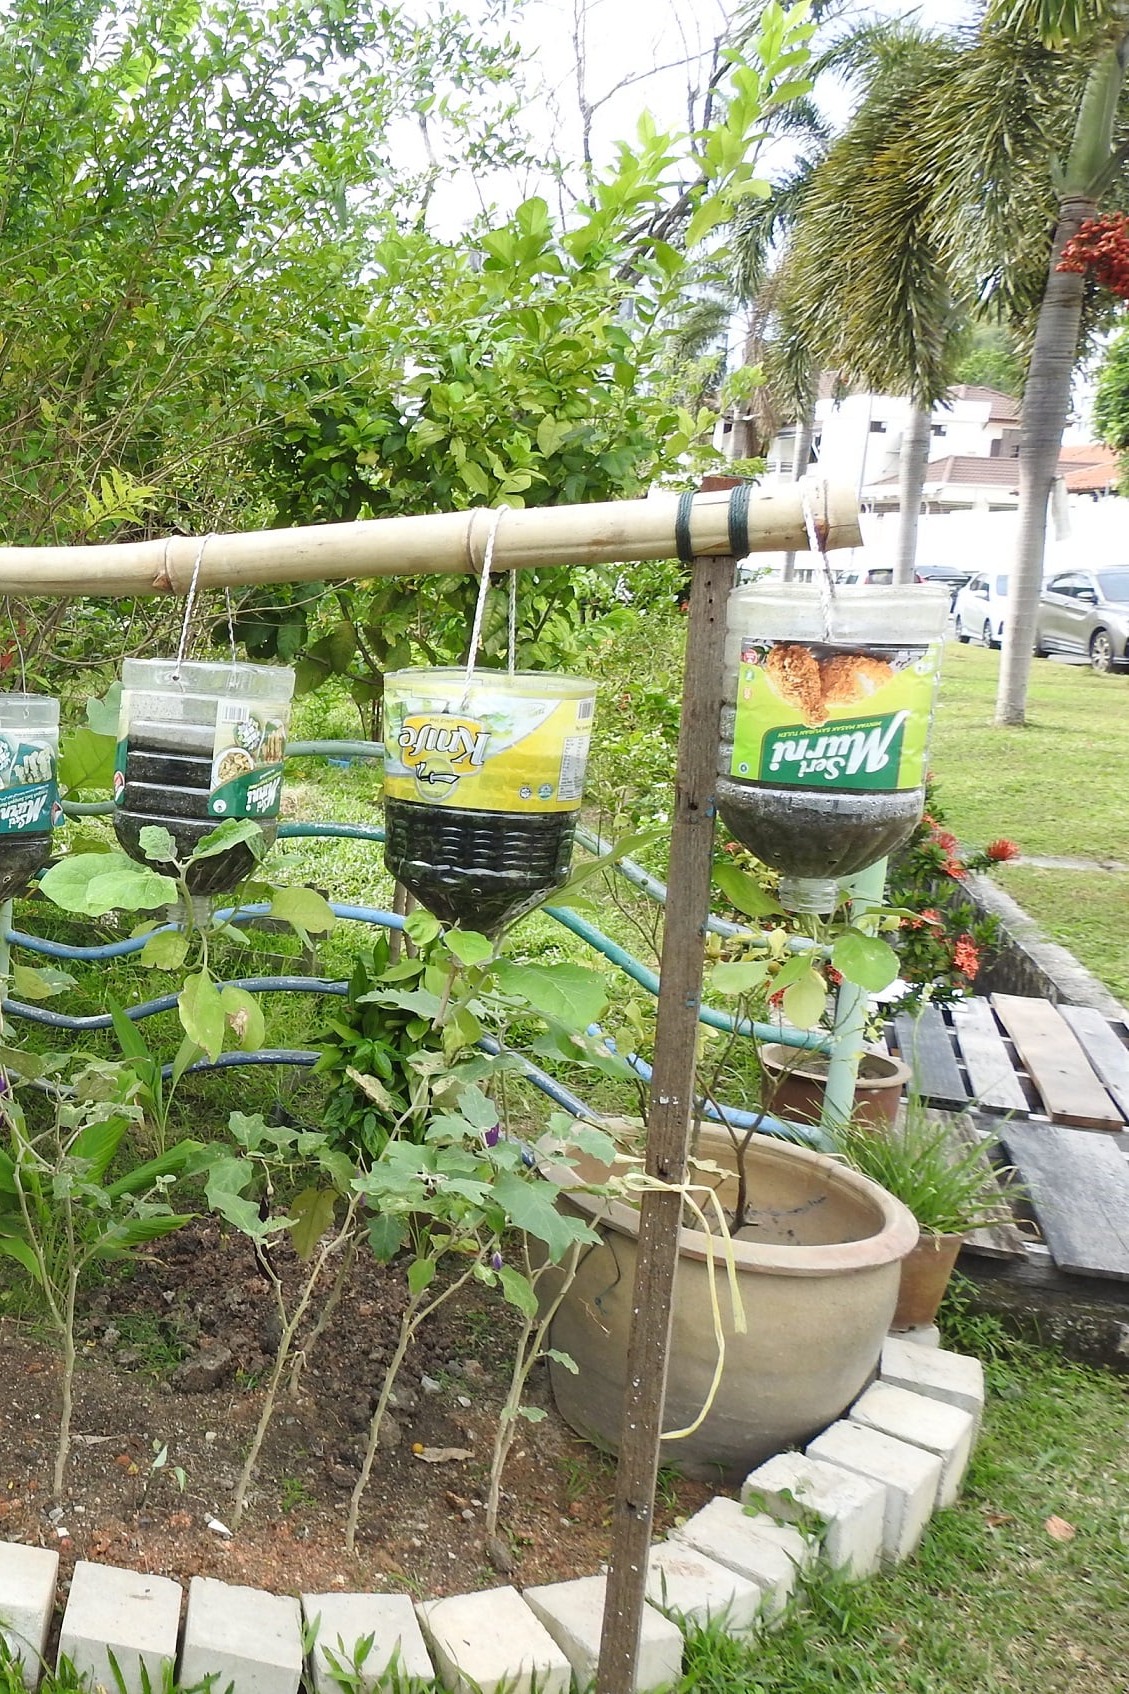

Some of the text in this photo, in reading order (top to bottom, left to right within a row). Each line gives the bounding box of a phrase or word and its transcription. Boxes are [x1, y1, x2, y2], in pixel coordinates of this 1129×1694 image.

[398, 724, 491, 766] Knife
[769, 709, 910, 771] Murni
[798, 756, 846, 779] Seri
